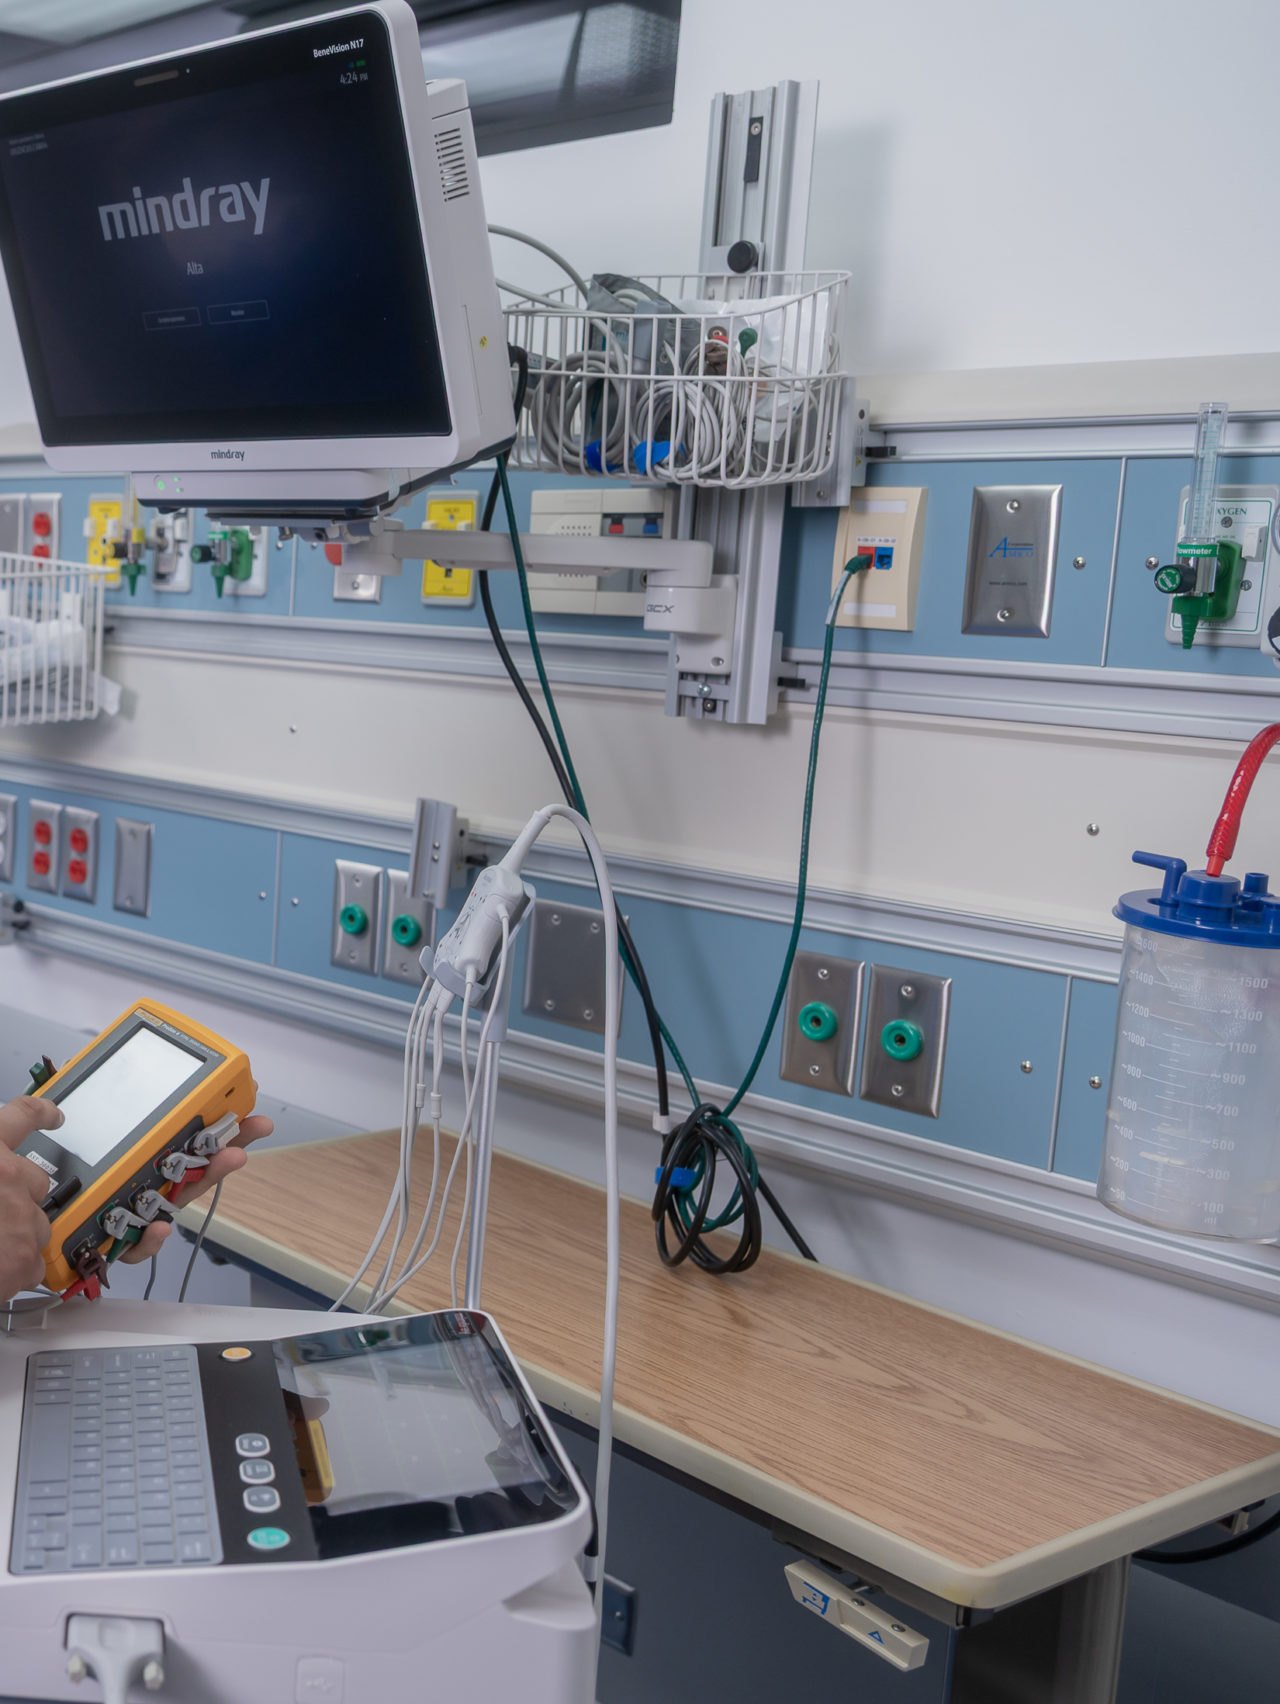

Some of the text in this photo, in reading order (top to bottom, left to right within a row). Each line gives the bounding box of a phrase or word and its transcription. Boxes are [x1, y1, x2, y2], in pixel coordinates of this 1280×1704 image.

[313, 38, 364, 58] BeneVision N17
[97, 177, 270, 241] mindray
[186, 261, 204, 275] Alta
[210, 449, 245, 461] mindray
